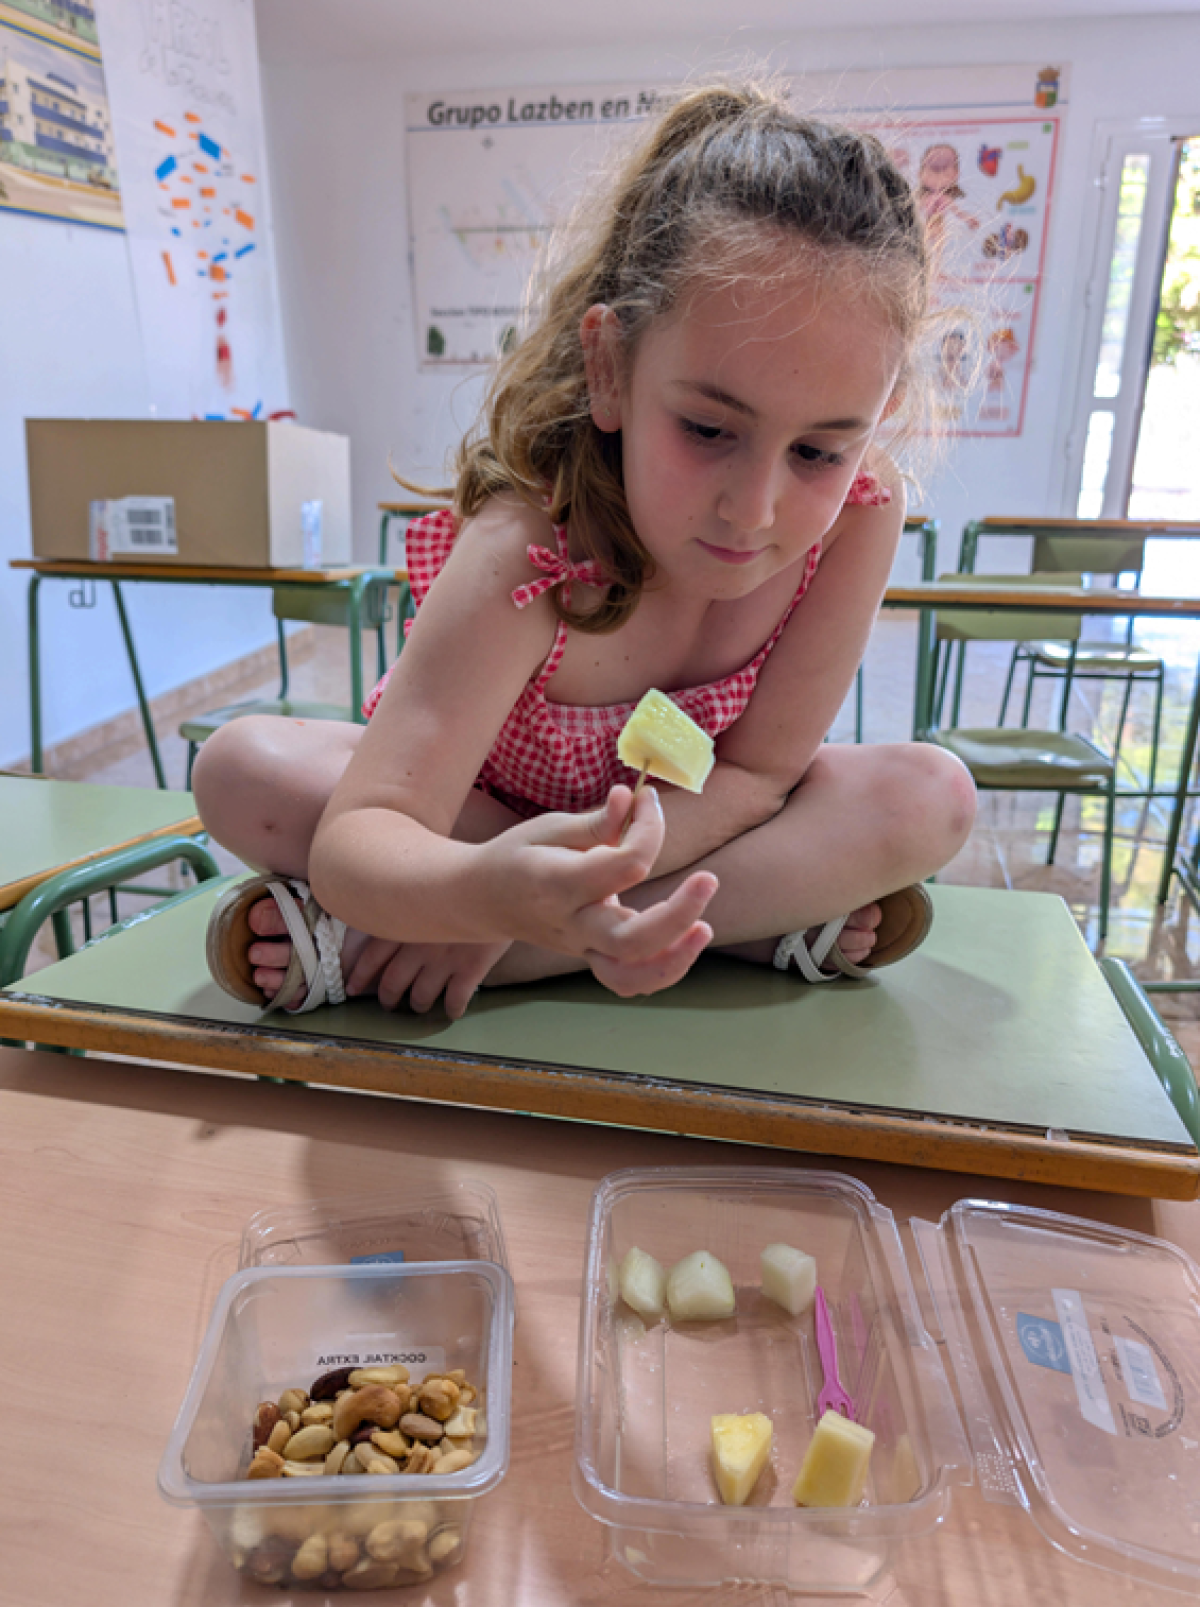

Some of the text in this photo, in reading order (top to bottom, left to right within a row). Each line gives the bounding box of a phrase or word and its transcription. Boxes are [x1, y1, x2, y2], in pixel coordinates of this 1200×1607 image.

[427, 100, 501, 130] Grupo
[507, 93, 594, 122] Lazben
[600, 98, 629, 118] en
